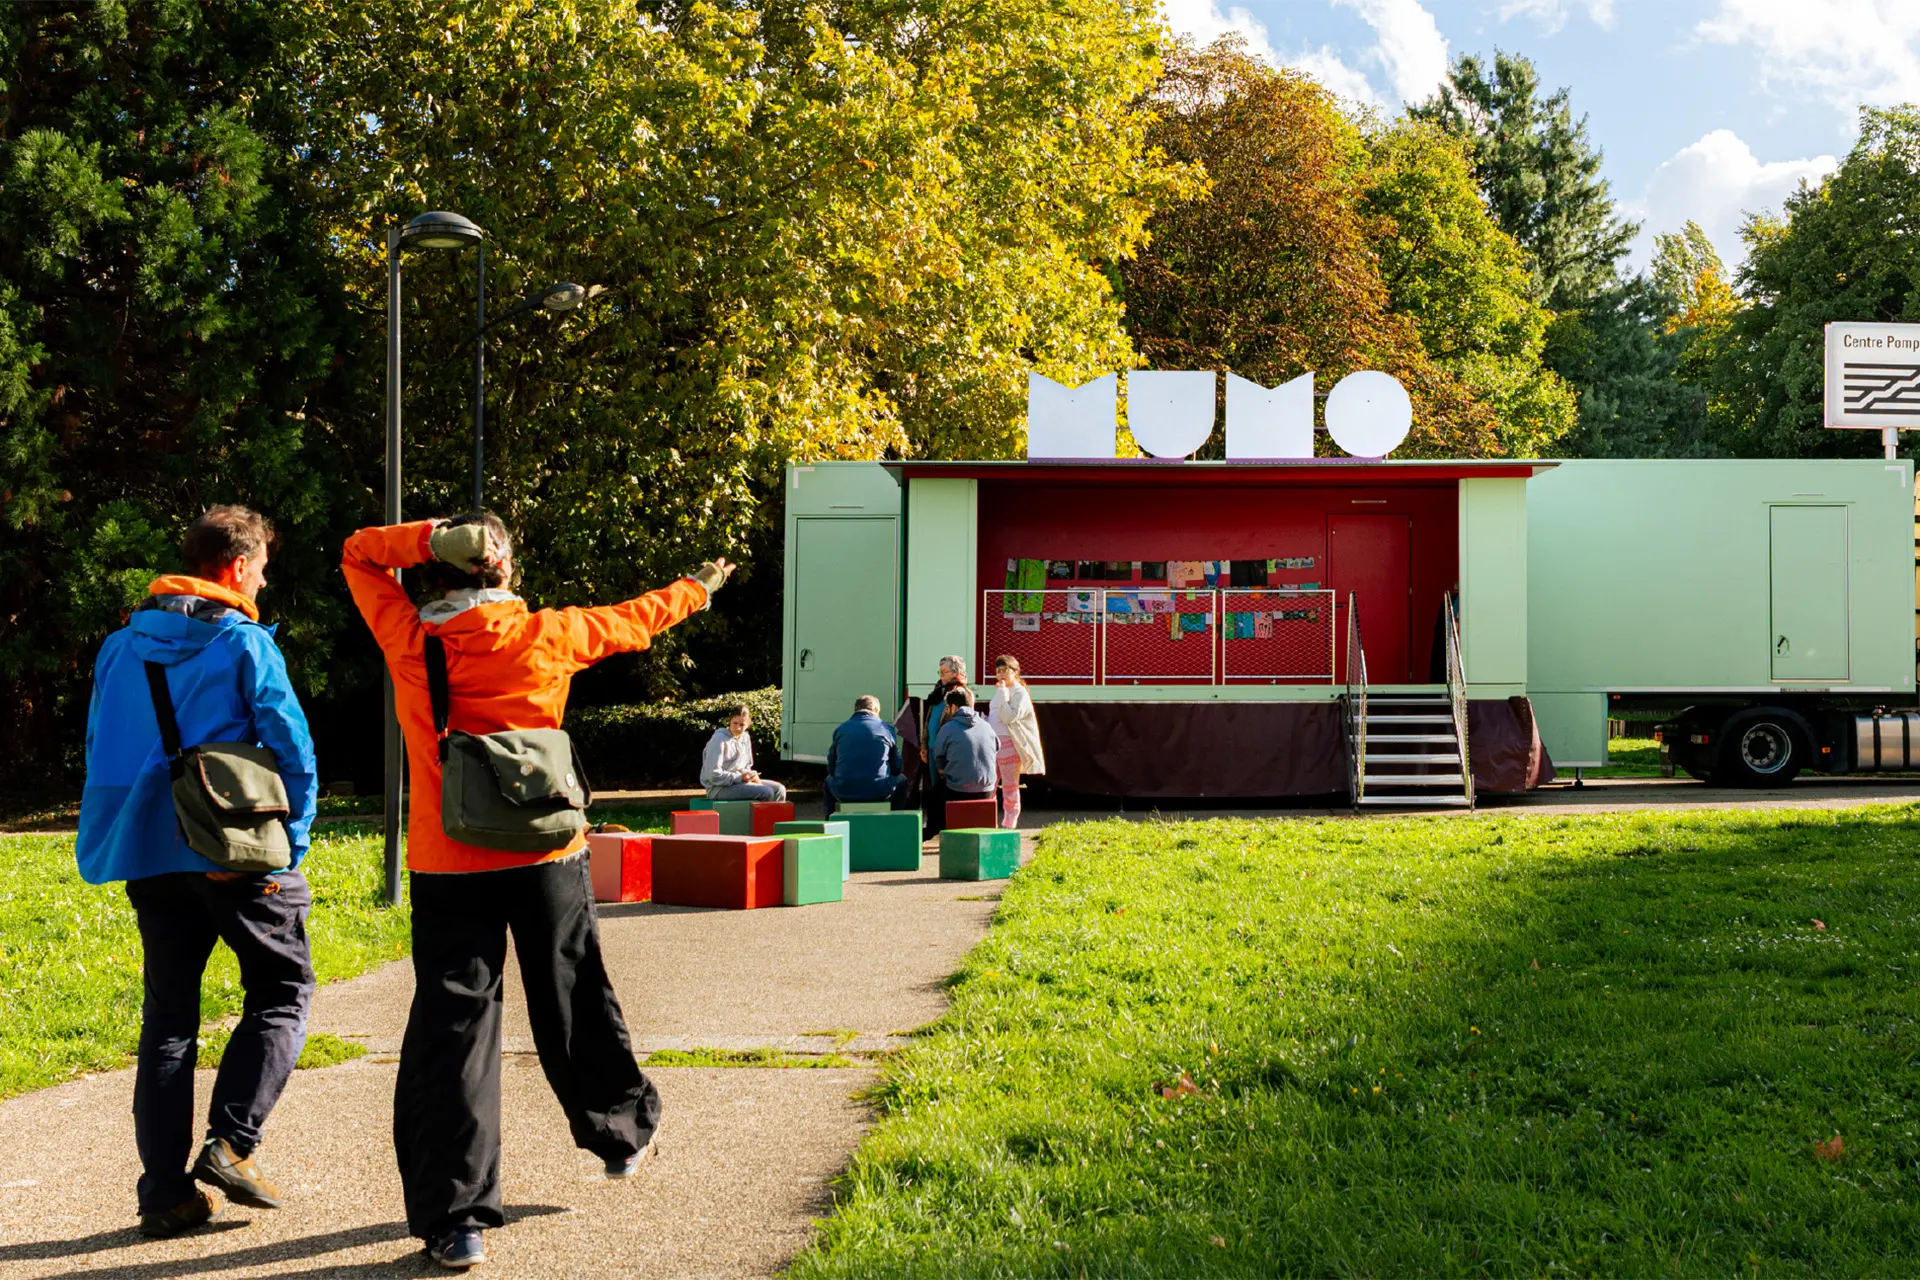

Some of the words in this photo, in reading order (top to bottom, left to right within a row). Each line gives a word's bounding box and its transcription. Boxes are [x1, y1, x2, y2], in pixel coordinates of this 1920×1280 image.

[1843, 334, 1883, 348] Centre
[1887, 335, 1920, 352] Pomp
[1027, 370, 1413, 459] MUMO
